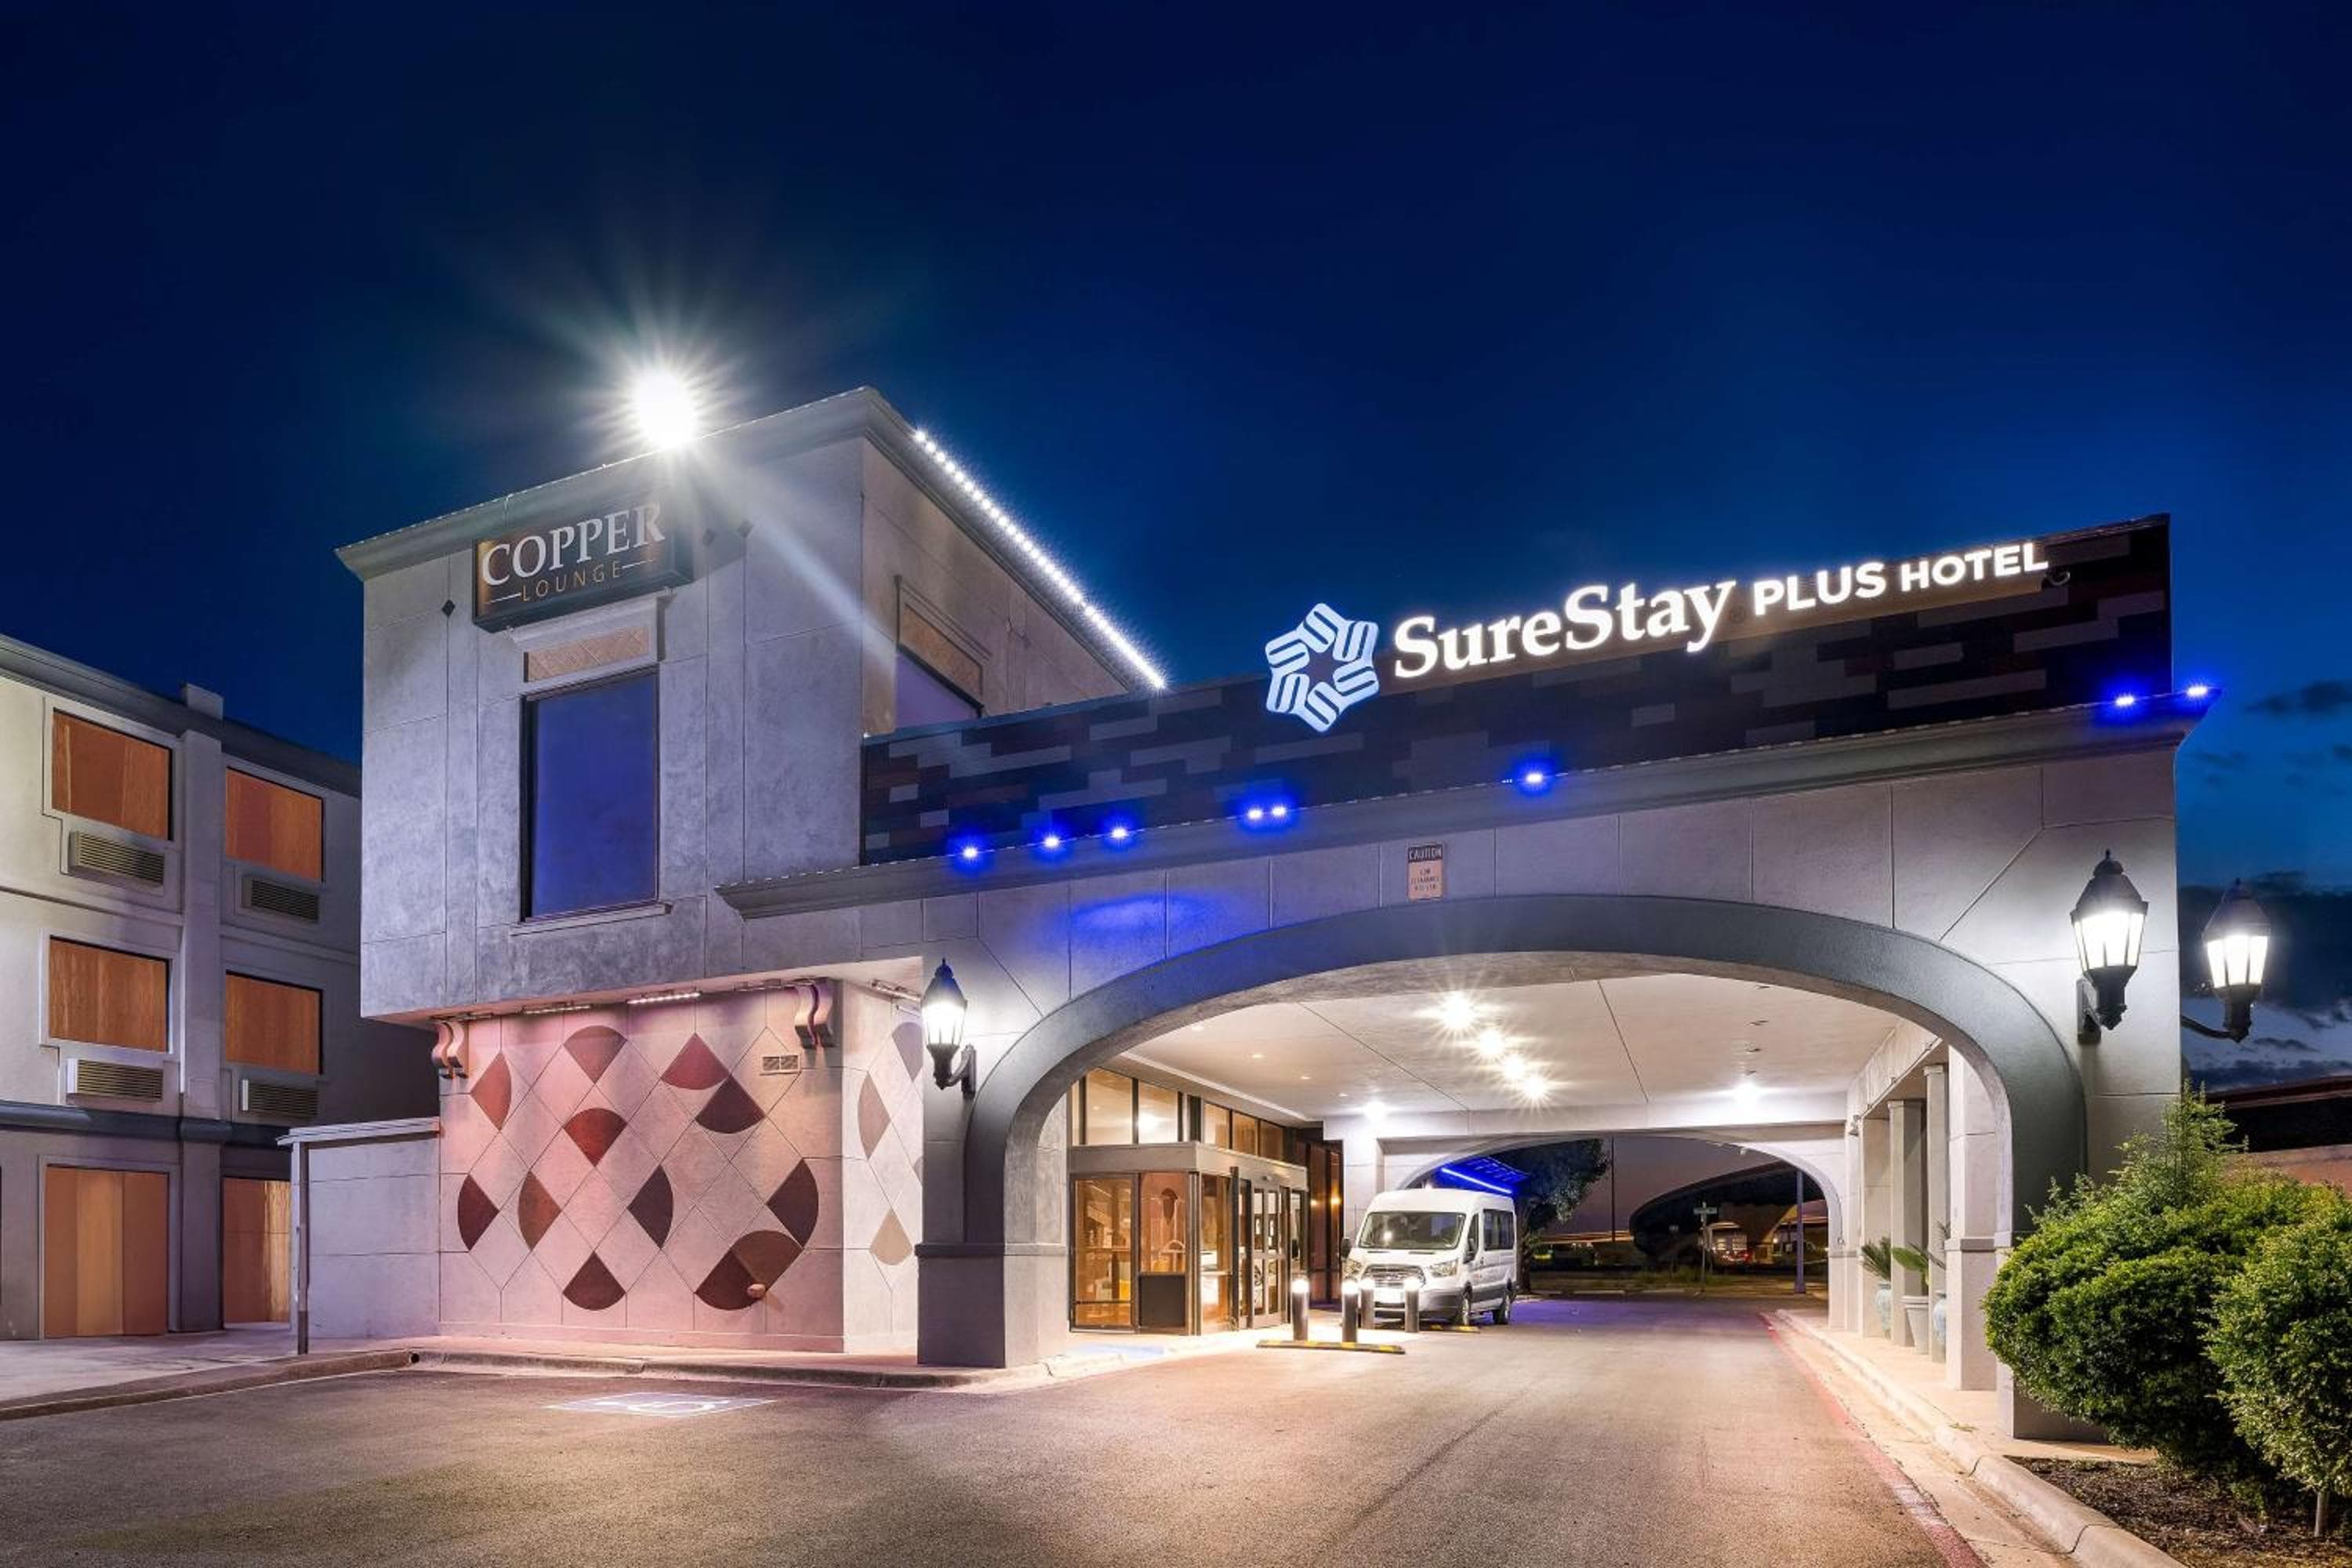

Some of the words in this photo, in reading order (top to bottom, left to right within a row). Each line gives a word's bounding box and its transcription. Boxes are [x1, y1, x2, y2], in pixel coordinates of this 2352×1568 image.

[482, 502, 666, 586] COPPER
[522, 561, 623, 601] LOUNGE
[1394, 580, 1737, 678] SureStay
[1753, 562, 1886, 615] PLUS
[1900, 543, 2049, 591] HOTEL
[1409, 847, 1442, 860] CAUTION
